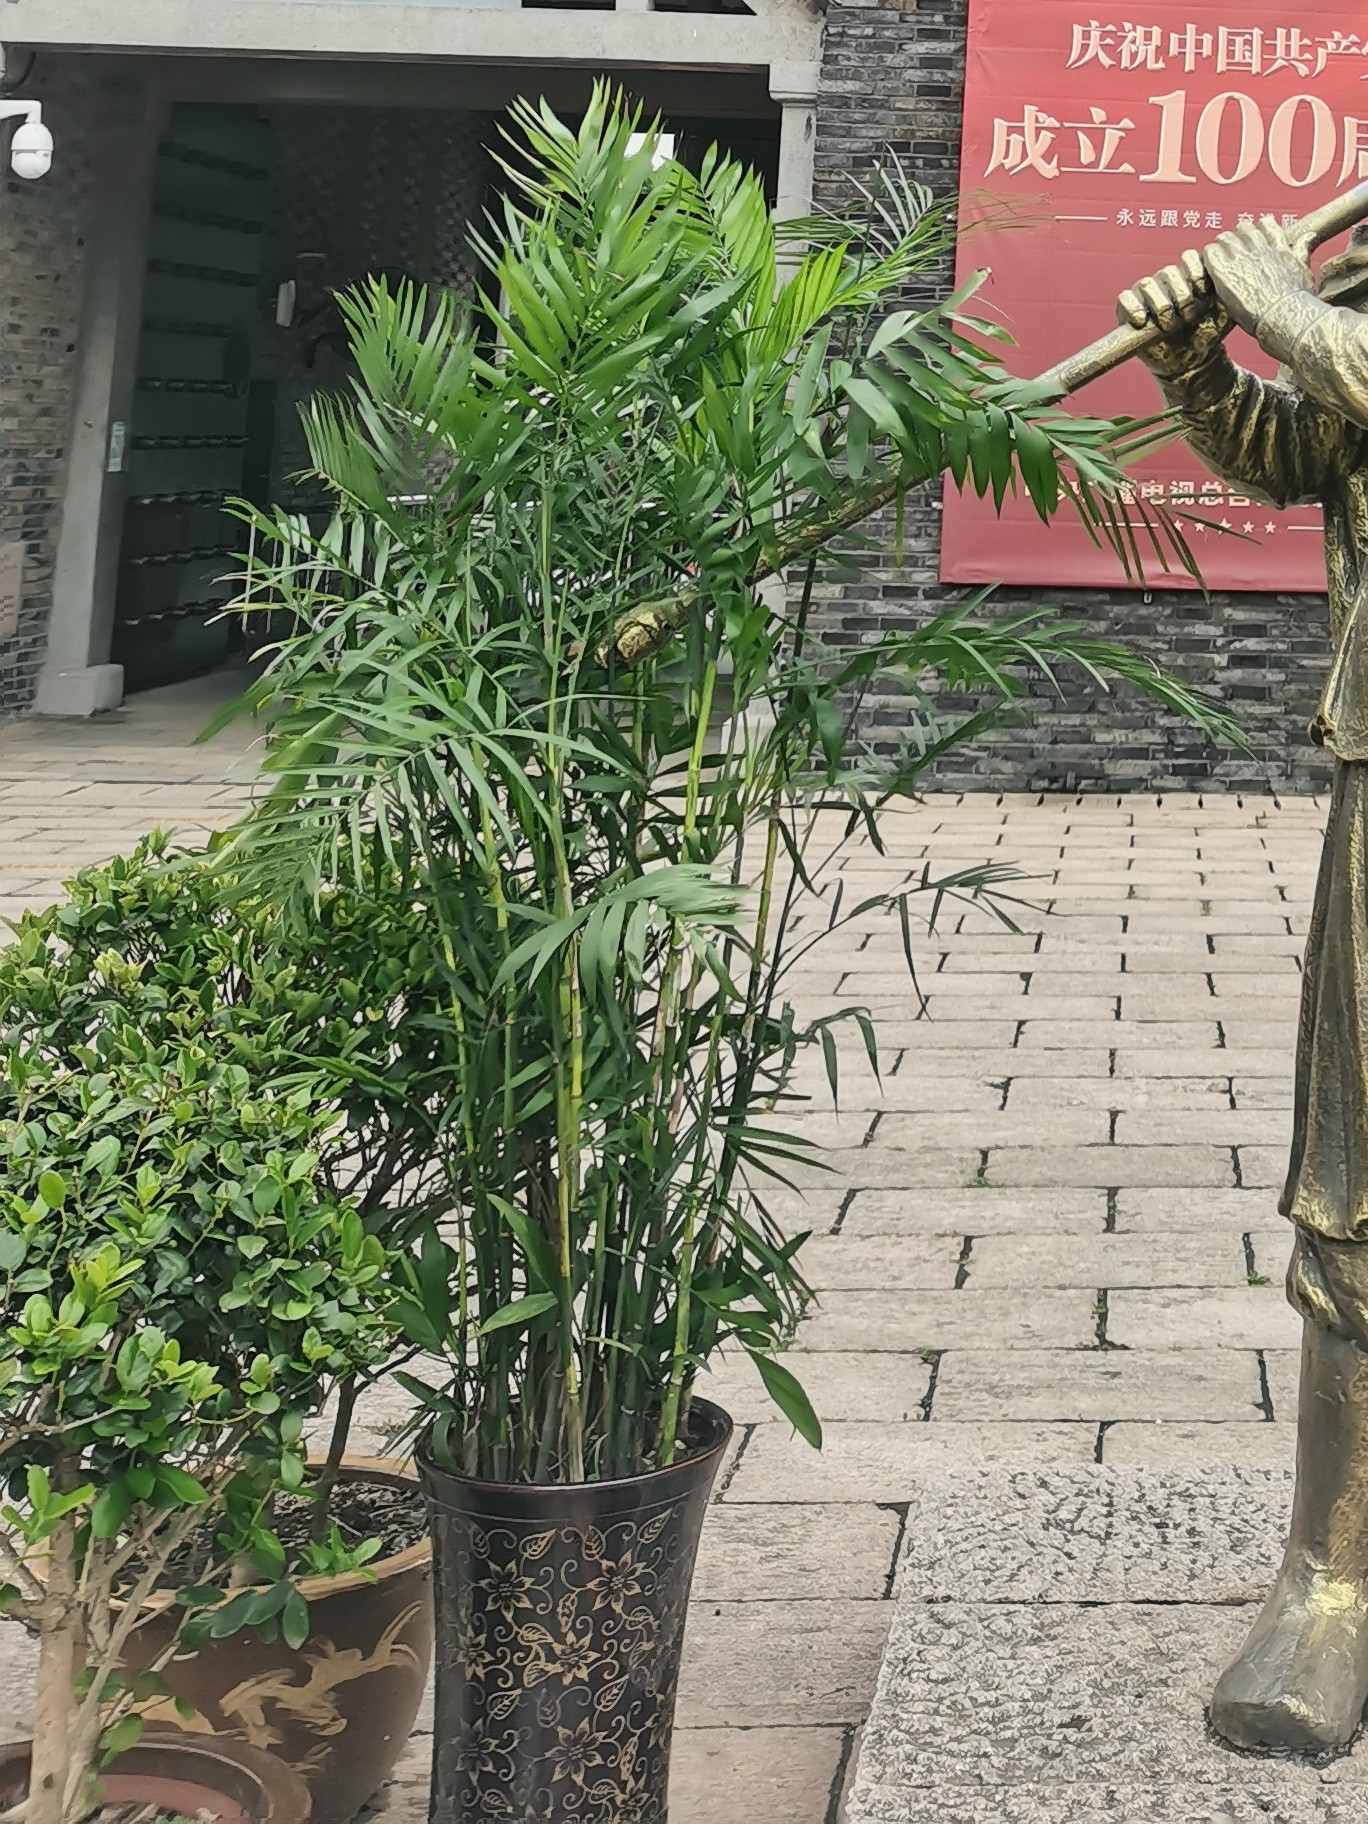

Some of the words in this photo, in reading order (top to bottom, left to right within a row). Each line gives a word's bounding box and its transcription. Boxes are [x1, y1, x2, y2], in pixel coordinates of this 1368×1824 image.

[1115, 208, 1223, 230] 永远跟党走
